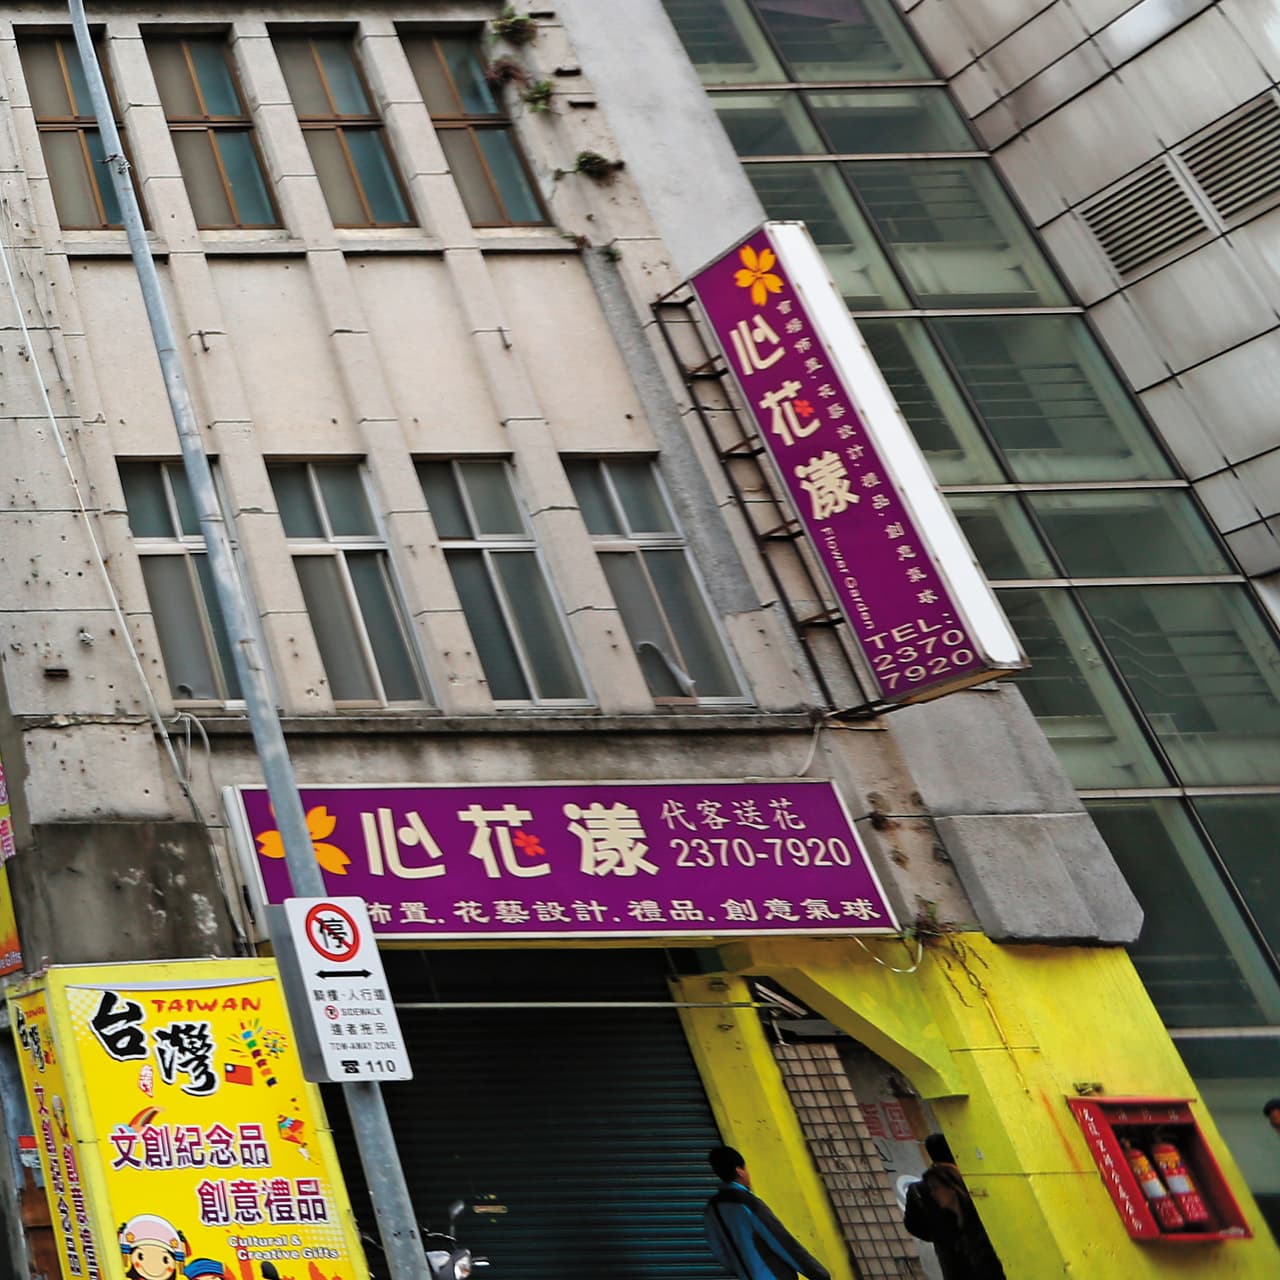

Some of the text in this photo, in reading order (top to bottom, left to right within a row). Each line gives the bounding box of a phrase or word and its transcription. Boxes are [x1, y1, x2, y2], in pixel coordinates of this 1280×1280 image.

[728, 313, 860, 521] 心花漾
[820, 527, 876, 630] Flower Garden
[875, 629, 966, 672] 2370
[884, 647, 975, 690] 7920
[659, 798, 807, 832] 代客送花
[359, 801, 661, 880] 心花漾
[668, 837, 852, 869] 2370-7920
[150, 997, 261, 1013] TAIWAN
[341, 1007, 383, 1016] SIDEWALK
[90, 990, 218, 1096] 台灣
[374, 1041, 397, 1049] ZONE
[366, 1059, 396, 1072] 110
[109, 1123, 272, 1171] 文創紀念品
[197, 1178, 329, 1225] 創意禮品
[227, 1235, 302, 1248] Cultural &
[236, 1247, 339, 1261] Creative Gifts
